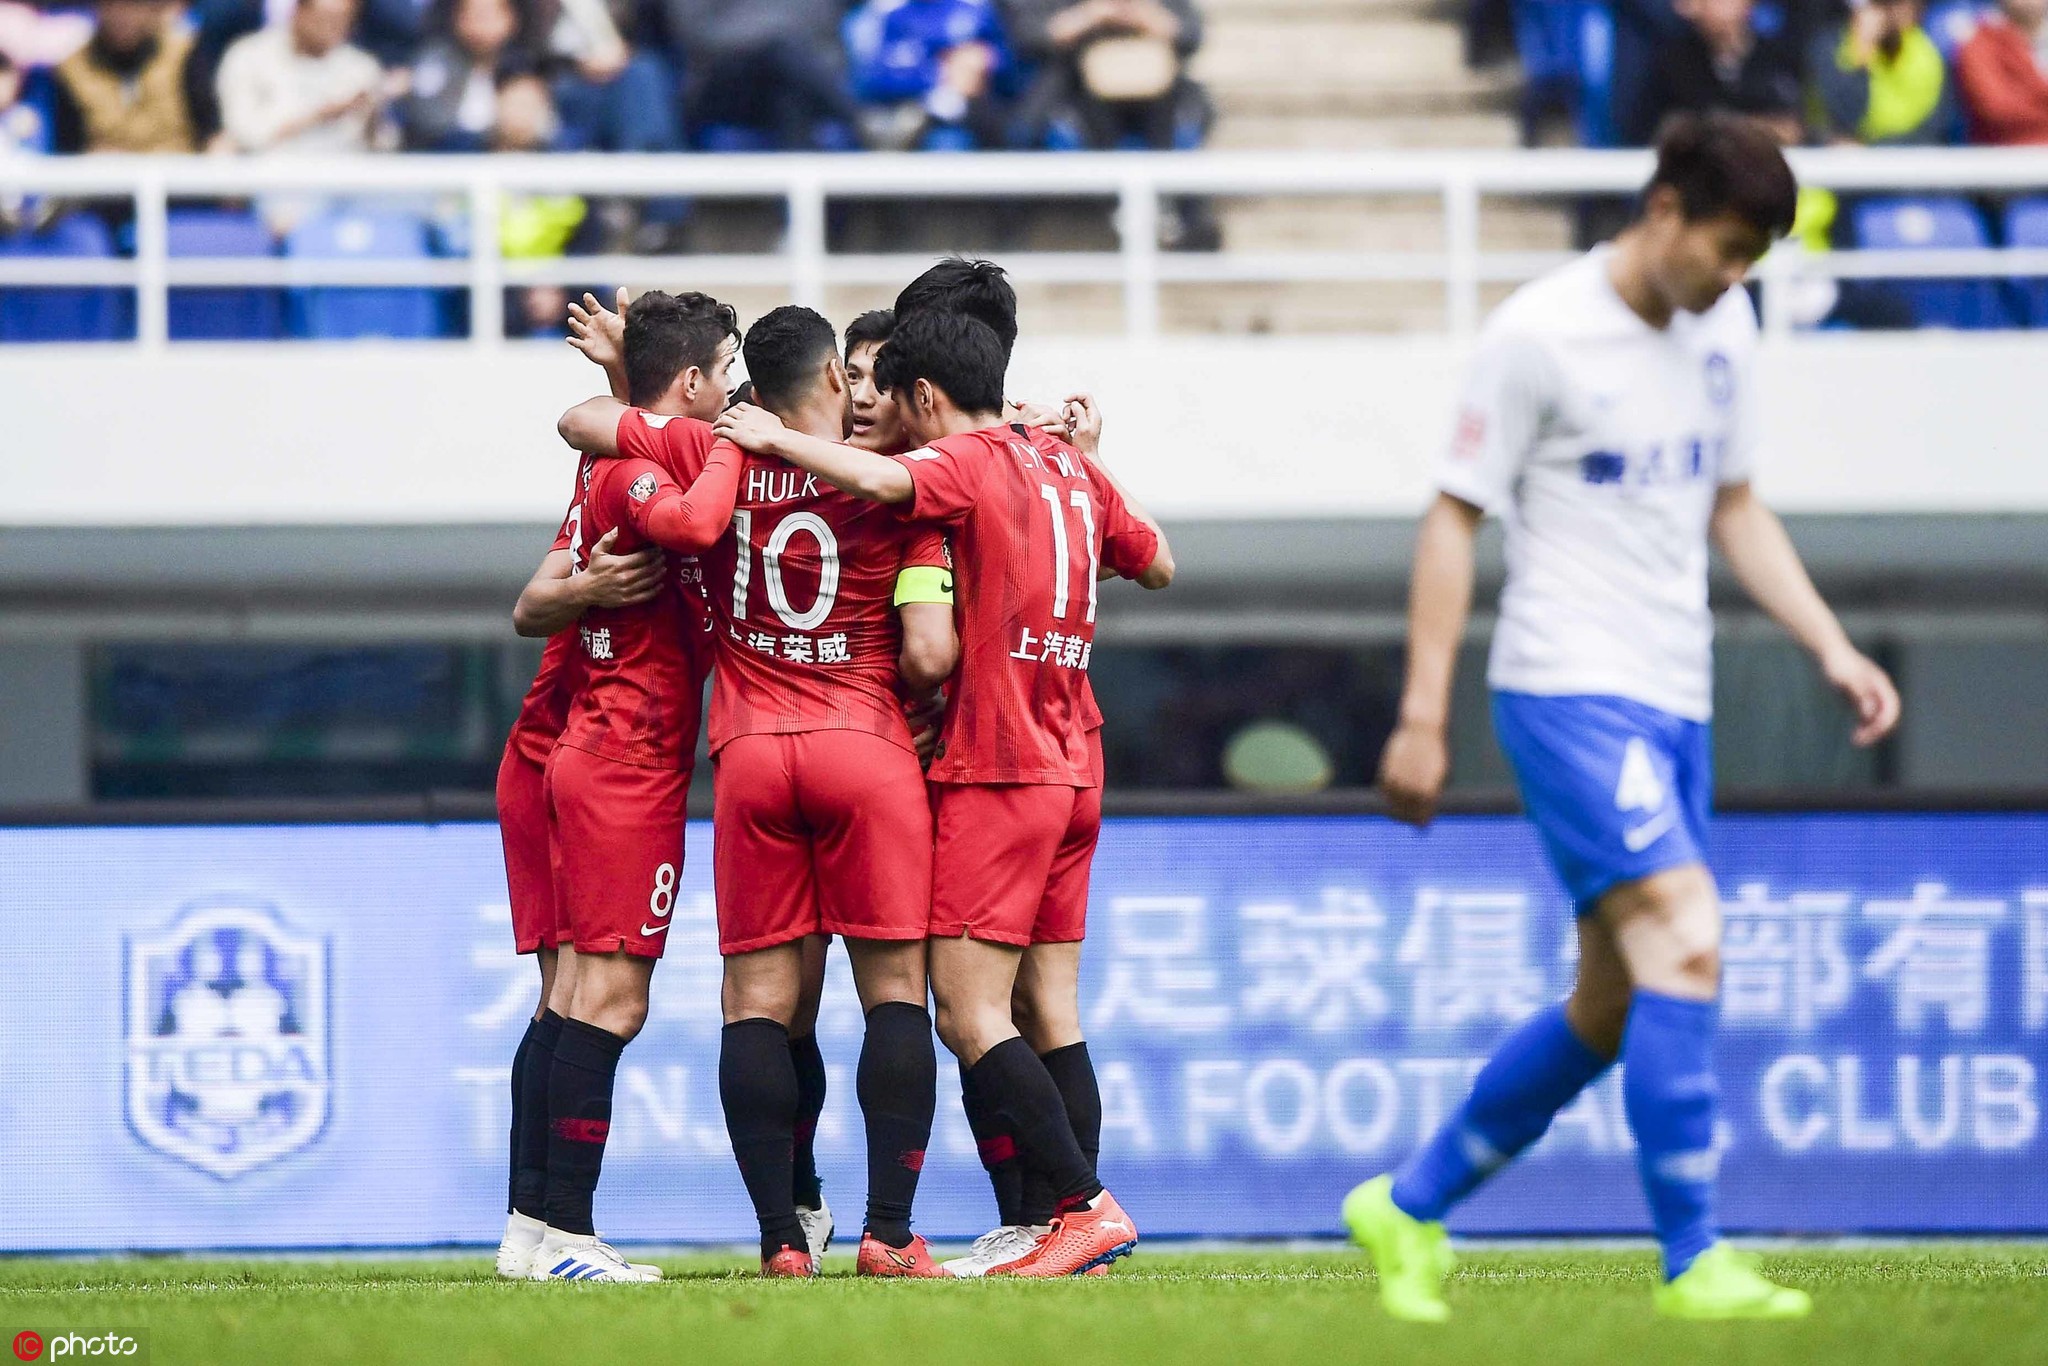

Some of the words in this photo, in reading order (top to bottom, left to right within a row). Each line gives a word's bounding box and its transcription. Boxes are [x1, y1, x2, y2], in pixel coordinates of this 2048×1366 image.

[748, 470, 819, 502] HULK
[732, 508, 840, 631] 10
[1041, 483, 1097, 623] 11
[1614, 736, 1664, 814] 4
[650, 862, 675, 918] 8
[1759, 1052, 2039, 1151] CLUB
